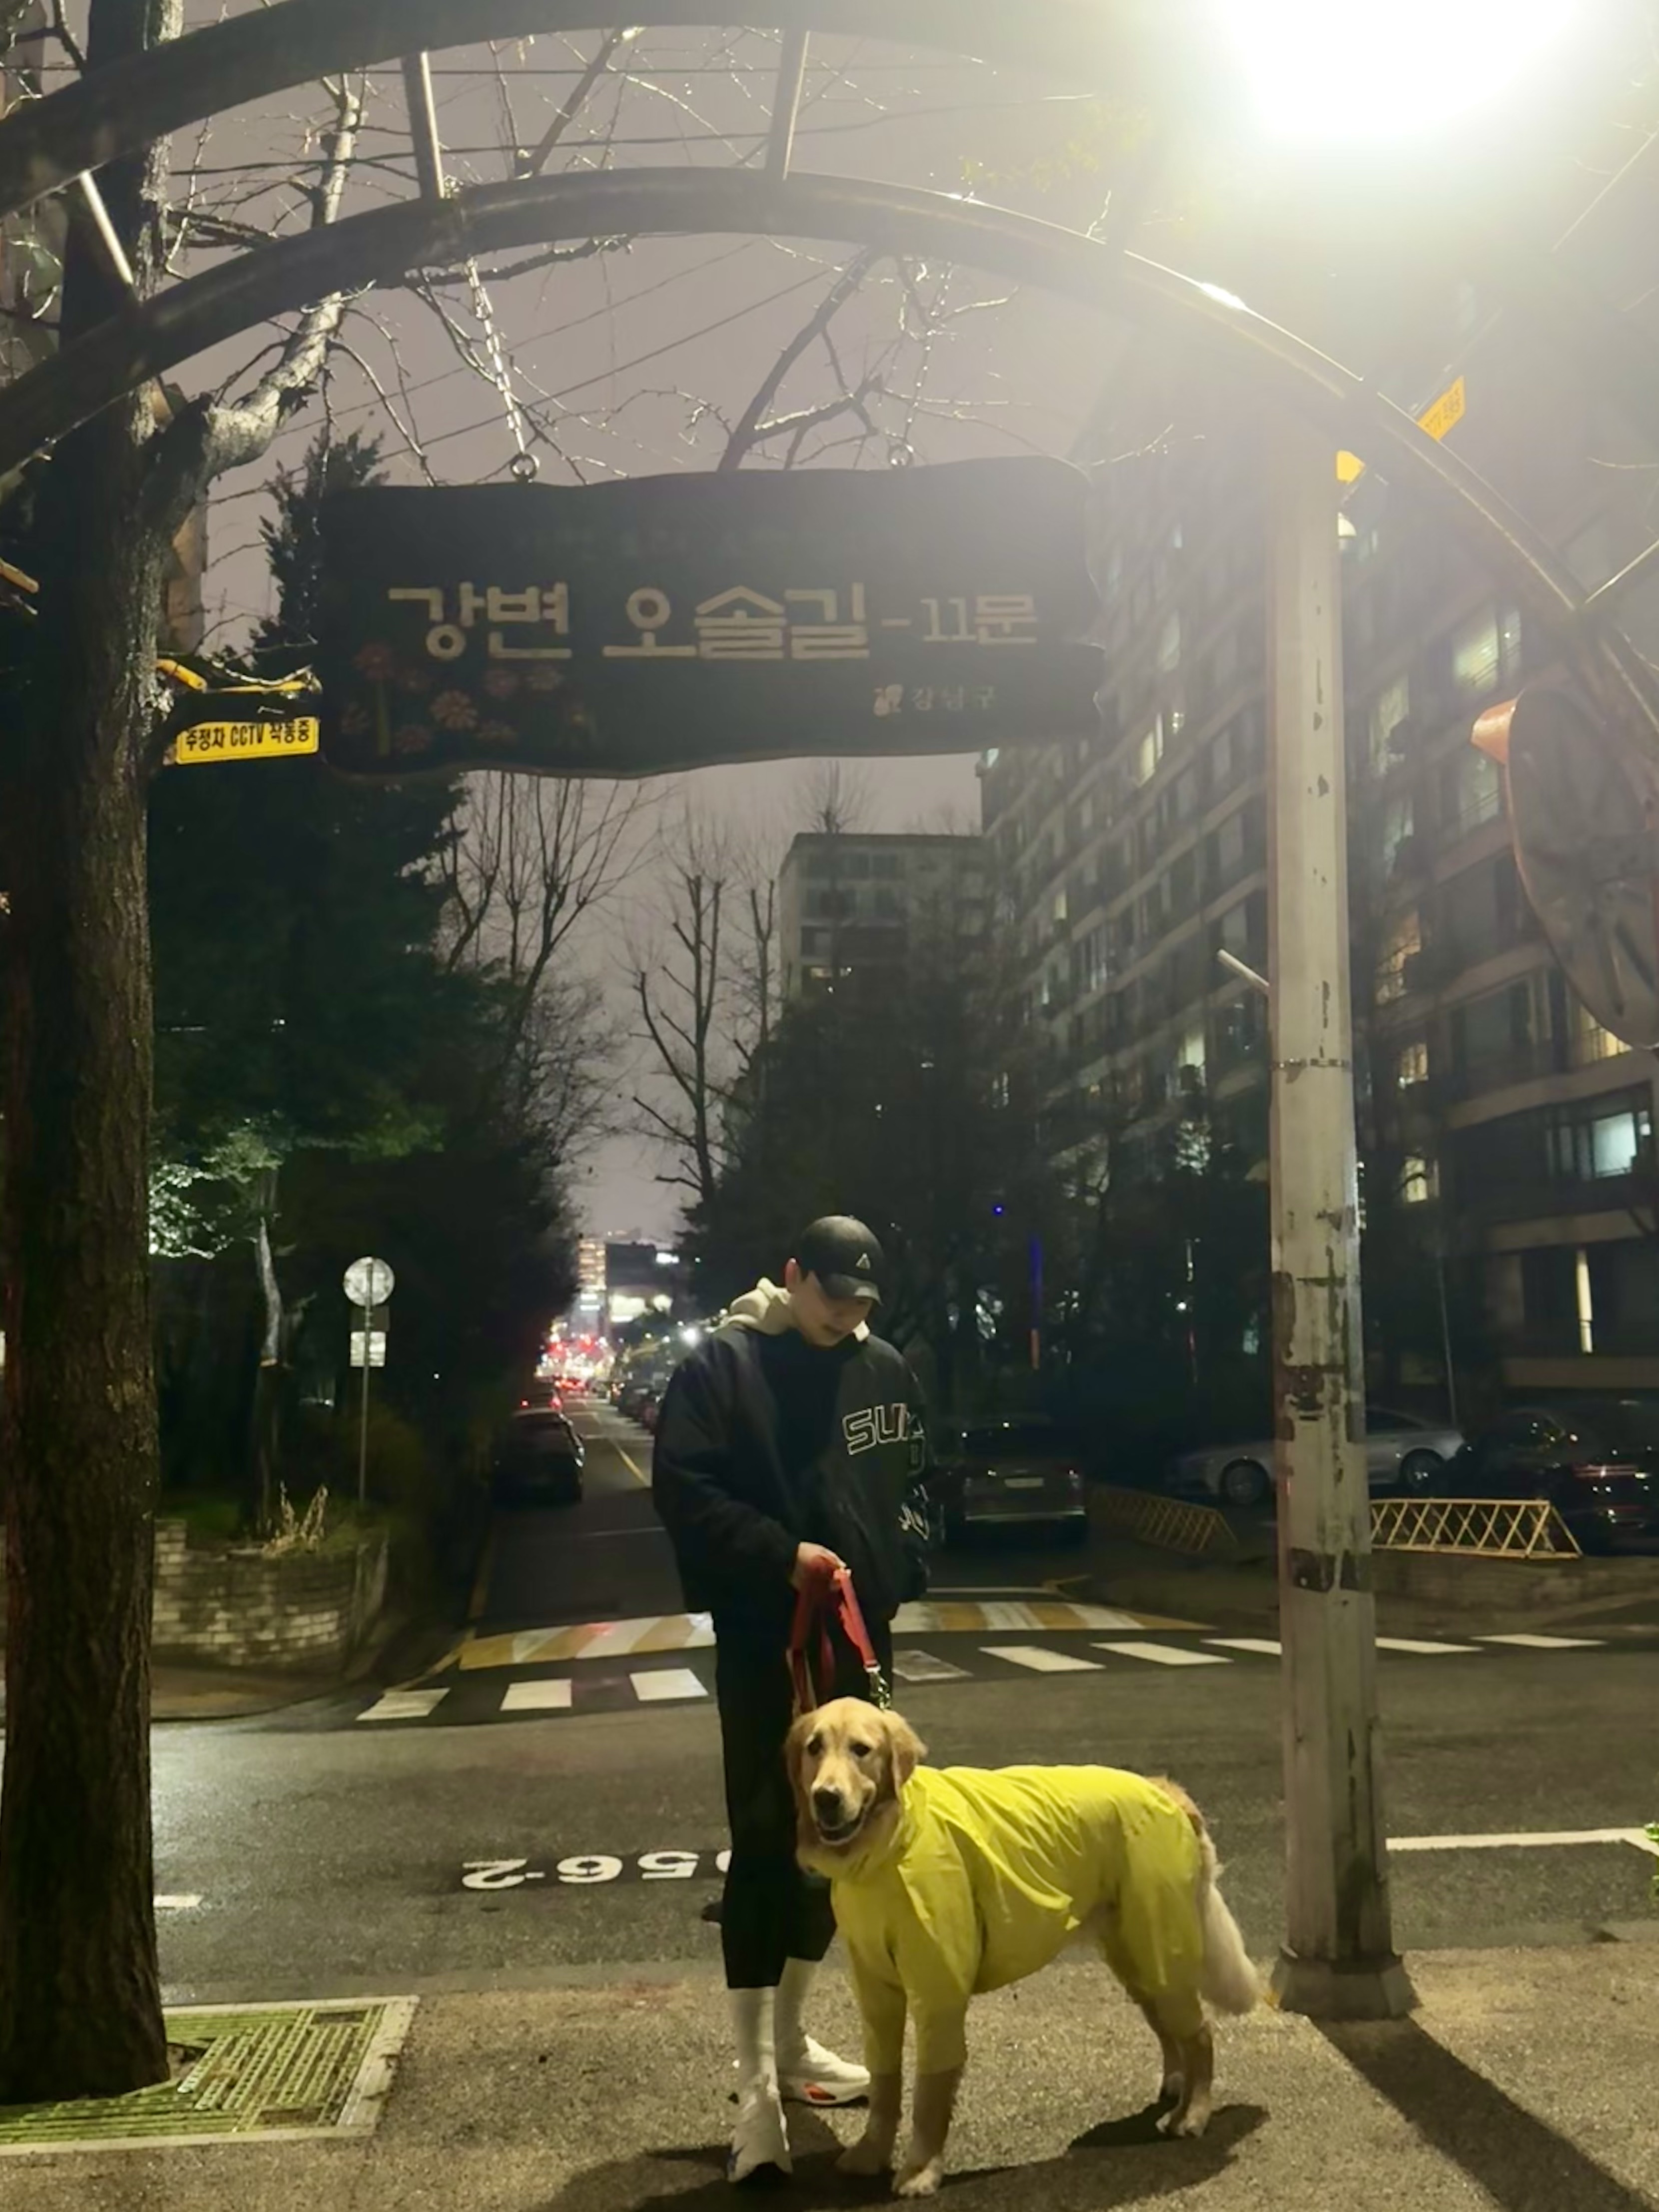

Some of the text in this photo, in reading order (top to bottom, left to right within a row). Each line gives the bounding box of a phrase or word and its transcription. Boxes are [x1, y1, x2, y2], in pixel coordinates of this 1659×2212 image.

[388, 581, 572, 660] 강변
[186, 719, 310, 752] 주정차 CCTV 작동중
